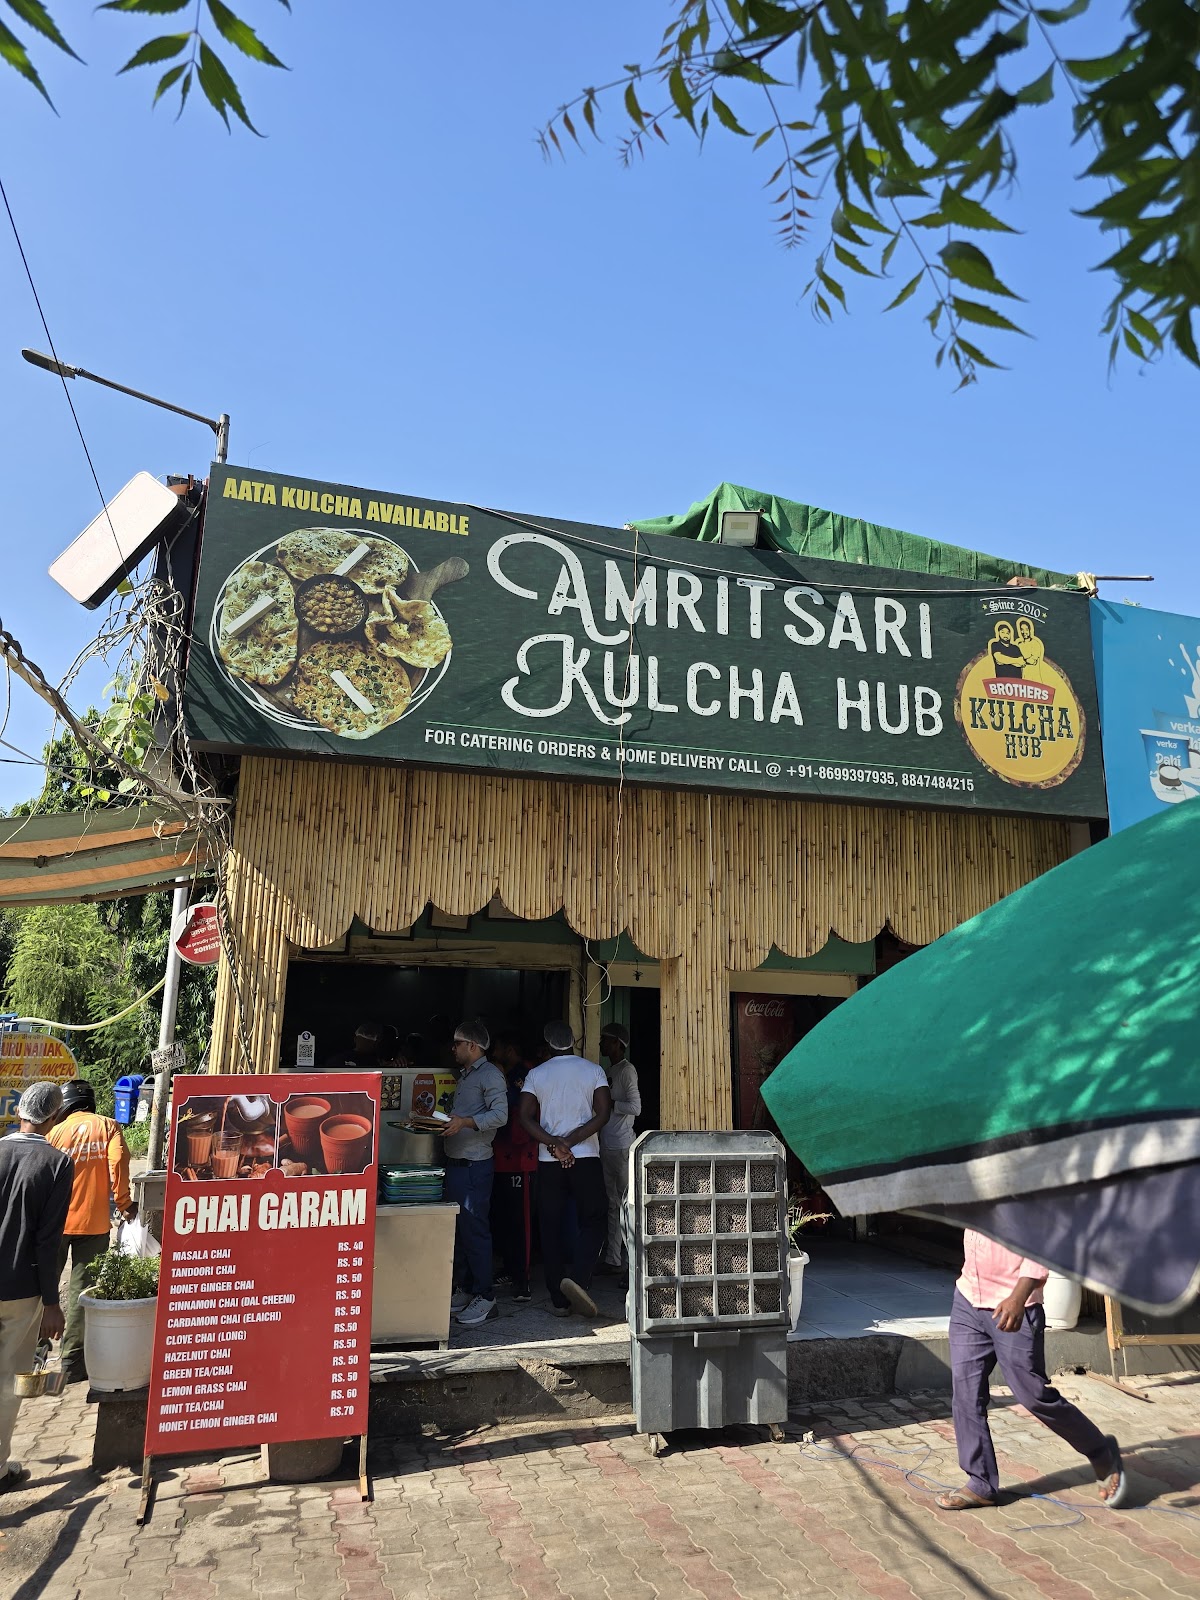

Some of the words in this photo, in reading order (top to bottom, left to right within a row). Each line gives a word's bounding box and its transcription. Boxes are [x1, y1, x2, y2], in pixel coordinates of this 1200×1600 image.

[223, 478, 276, 505] AATA
[281, 487, 363, 519] KULCHA
[365, 502, 469, 536] AVAILABLE
[486, 532, 933, 660] AMRITSARI
[989, 601, 1015, 612] Since
[1017, 602, 1040, 618] 2010
[501, 633, 804, 726] KULCHA
[836, 677, 944, 737] HUB
[989, 683, 1049, 700] BROTHERS
[969, 697, 1074, 742] KULCHA
[1170, 722, 1200, 734] verka
[1005, 733, 1042, 759] HUB
[1156, 740, 1178, 748] verka
[425, 729, 456, 746] FOR
[460, 733, 533, 753] CATERING
[538, 740, 596, 758] ORDERS
[601, 747, 611, 760] &
[616, 748, 656, 764] HOME
[660, 751, 724, 770] DELIVERY
[729, 758, 761, 774] CALL
[765, 762, 781, 777] @
[901, 773, 974, 791] 8847484215
[1156, 753, 1181, 766] Dahi
[0, 1042, 22, 1056] URU
[23, 1042, 63, 1057] NANAK
[32, 1063, 76, 1077] TANKER
[511, 1175, 522, 1188] 12
[174, 1194, 251, 1235] CHAI
[258, 1188, 367, 1231] GARAM
[338, 1242, 352, 1252] RS.
[353, 1241, 364, 1251] 40
[172, 1250, 209, 1261] MASALA
[210, 1249, 231, 1259] CHAI
[337, 1258, 350, 1268] RS.
[352, 1257, 363, 1267] 50
[171, 1266, 214, 1278] TANDOORI
[216, 1265, 236, 1275] CHAI
[336, 1274, 350, 1284] RS.
[352, 1273, 362, 1283] 50
[170, 1284, 199, 1294] HONEY
[200, 1282, 232, 1293] GINGER
[234, 1280, 255, 1291] CHAI
[336, 1290, 349, 1300] RS.
[351, 1289, 361, 1299] 50
[169, 1299, 216, 1311] CINNAMON
[218, 1298, 239, 1308] CHAI
[241, 1296, 261, 1308] (DAL
[262, 1294, 296, 1306] CHEENI)
[334, 1307, 348, 1317] RS.
[350, 1306, 361, 1315] 50
[167, 1316, 218, 1328] CARDAMOM
[221, 1314, 241, 1325] CHAI
[243, 1311, 282, 1324] (ELAICHI)
[334, 1322, 358, 1333] RS.50
[166, 1335, 193, 1346] CLOVE
[195, 1333, 215, 1343] CHAI
[218, 1331, 247, 1342] (LONG)
[333, 1339, 357, 1350] RS.50
[165, 1350, 209, 1363] HAZELNUT
[210, 1349, 231, 1359] CHAI
[332, 1356, 346, 1366] RS.
[348, 1355, 359, 1365] 50
[163, 1369, 193, 1380] GREEN
[194, 1365, 233, 1378] TEA/CHAI
[331, 1373, 345, 1383] RS.
[348, 1372, 358, 1382] 50
[162, 1386, 193, 1398] LEMON
[195, 1384, 224, 1395] GRASS
[226, 1381, 247, 1391] CHAI
[331, 1390, 345, 1400] RS.
[346, 1388, 357, 1398] 60
[160, 1404, 183, 1415] MINT
[185, 1400, 224, 1413] TEA/CHAI
[330, 1406, 354, 1417] RS.70
[159, 1421, 188, 1433] HONEY
[190, 1418, 221, 1430] LEMON
[223, 1415, 255, 1426] GINGER
[257, 1413, 278, 1424] CHAI
